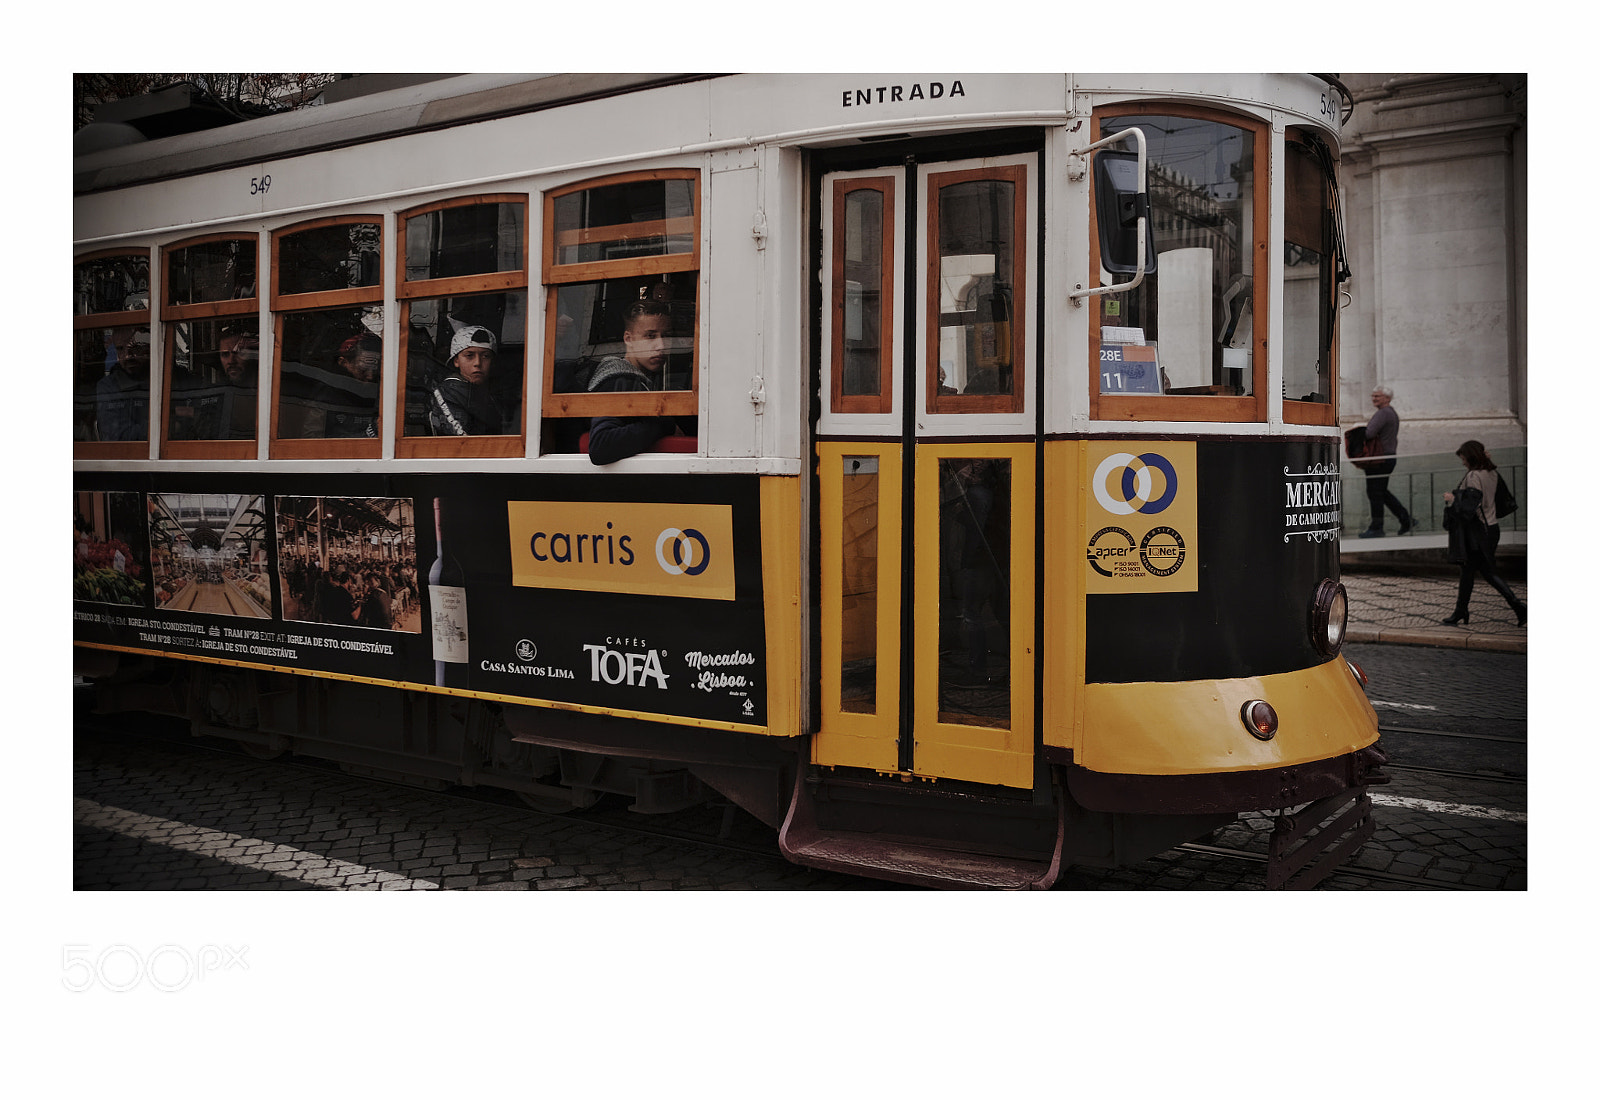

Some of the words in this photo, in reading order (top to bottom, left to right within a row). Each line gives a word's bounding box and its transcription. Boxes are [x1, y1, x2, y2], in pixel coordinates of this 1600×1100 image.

[842, 80, 965, 108] ENTRADA
[1320, 92, 1336, 122] 549
[250, 174, 272, 195] 549
[1099, 350, 1122, 361] 28E
[1102, 372, 1123, 389] 11
[1285, 513, 1298, 527] DE
[1299, 512, 1324, 525] CAMPO
[530, 521, 635, 566] carris
[1096, 548, 1128, 560] apcer
[1148, 547, 1177, 557] IQNet
[128, 617, 149, 629] IGREJA
[162, 621, 206, 635] CONDESTÁVEL
[139, 631, 157, 643] TRAM
[202, 639, 224, 651] IGREJA
[224, 641, 235, 652] DE
[249, 644, 299, 660] CONDESTÁVEL
[223, 627, 243, 638] TRAM
[260, 631, 276, 642] EXIT
[287, 634, 313, 647] IGREJA
[313, 637, 323, 648] DE
[323, 638, 340, 650] STO.
[340, 639, 394, 656] CONDESTÁVEL
[606, 636, 646, 648] CAFÉS
[480, 659, 507, 673] CASA
[507, 662, 546, 677] SANTOS
[547, 666, 575, 680] LIMA
[582, 643, 671, 690] TOFA
[684, 649, 756, 671] Mercados
[697, 670, 747, 693] Lisboa
